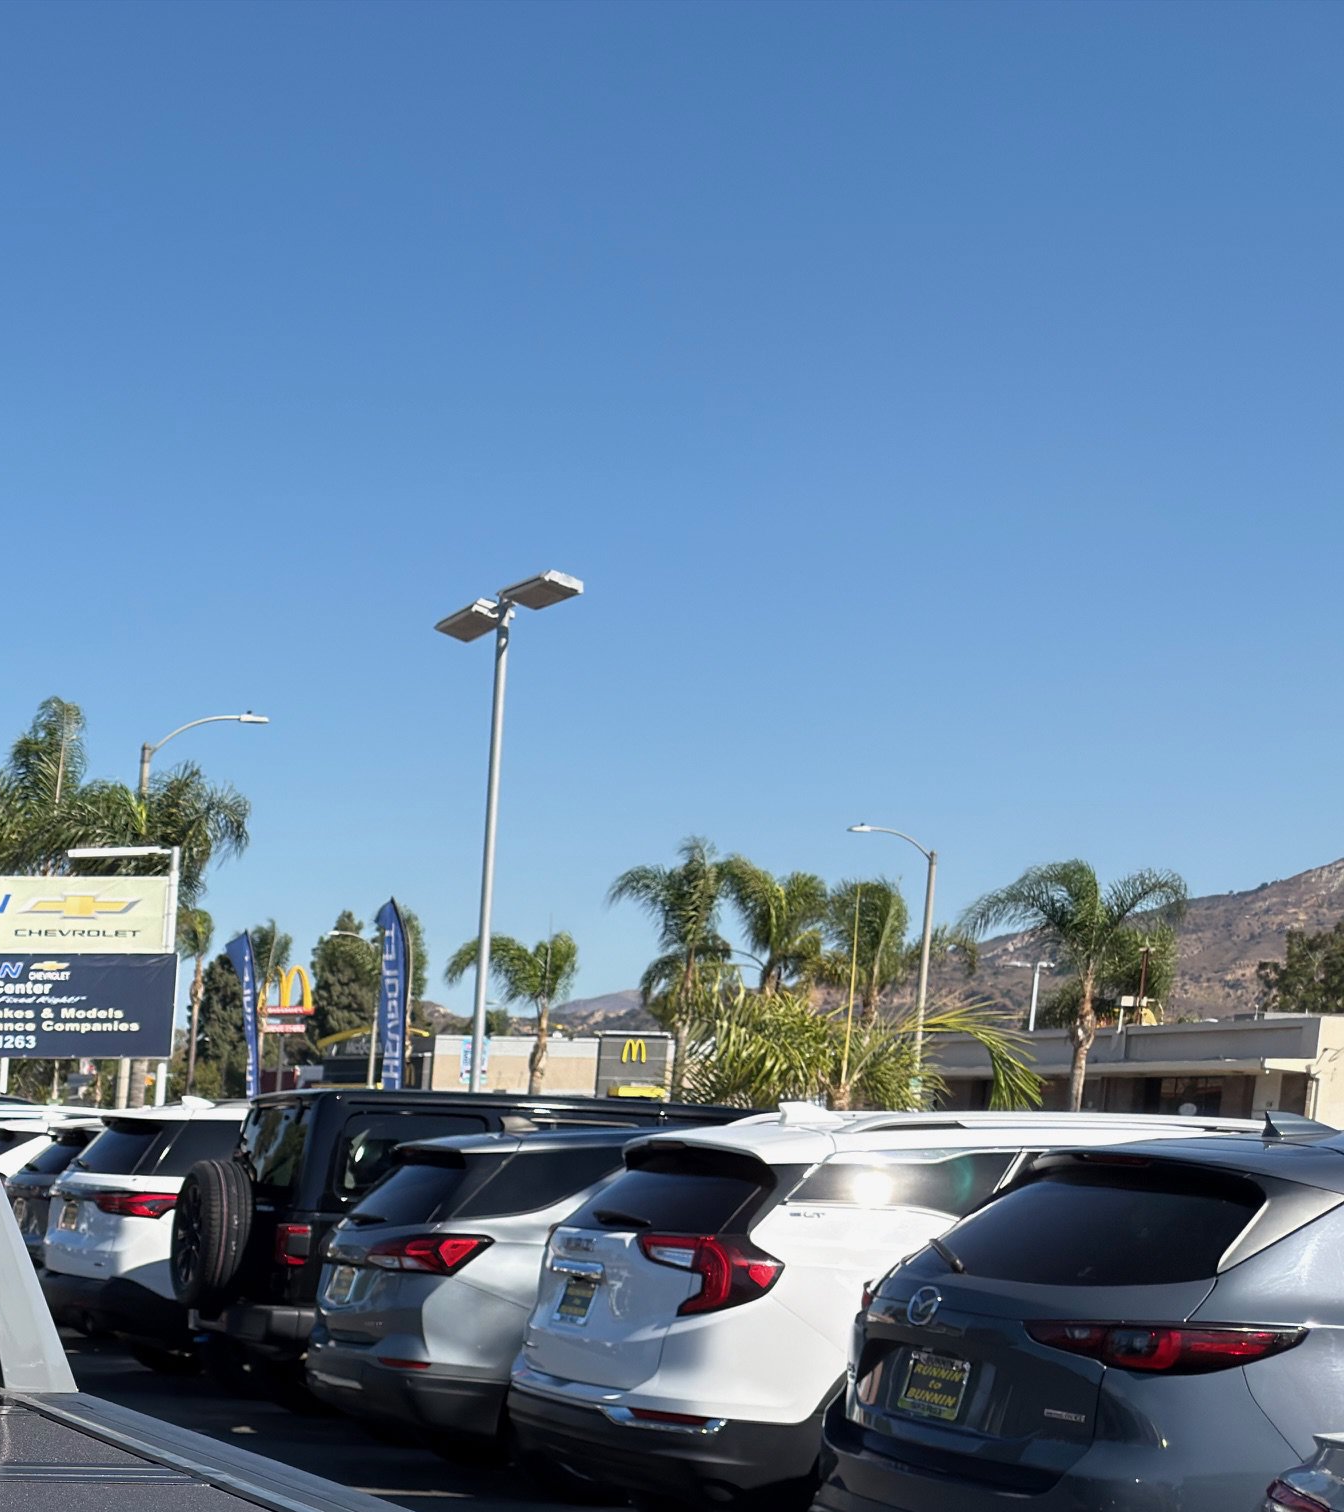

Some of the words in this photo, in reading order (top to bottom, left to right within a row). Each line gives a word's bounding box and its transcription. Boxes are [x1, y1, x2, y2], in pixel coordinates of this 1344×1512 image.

[13, 928, 141, 938] CHEVROLET
[28, 971, 72, 981] CHEVROLET
[40, 1007, 55, 1019] &
[60, 1007, 124, 1019] Models
[41, 1020, 140, 1034] Companies
[906, 1387, 957, 1408] BUNNIN
